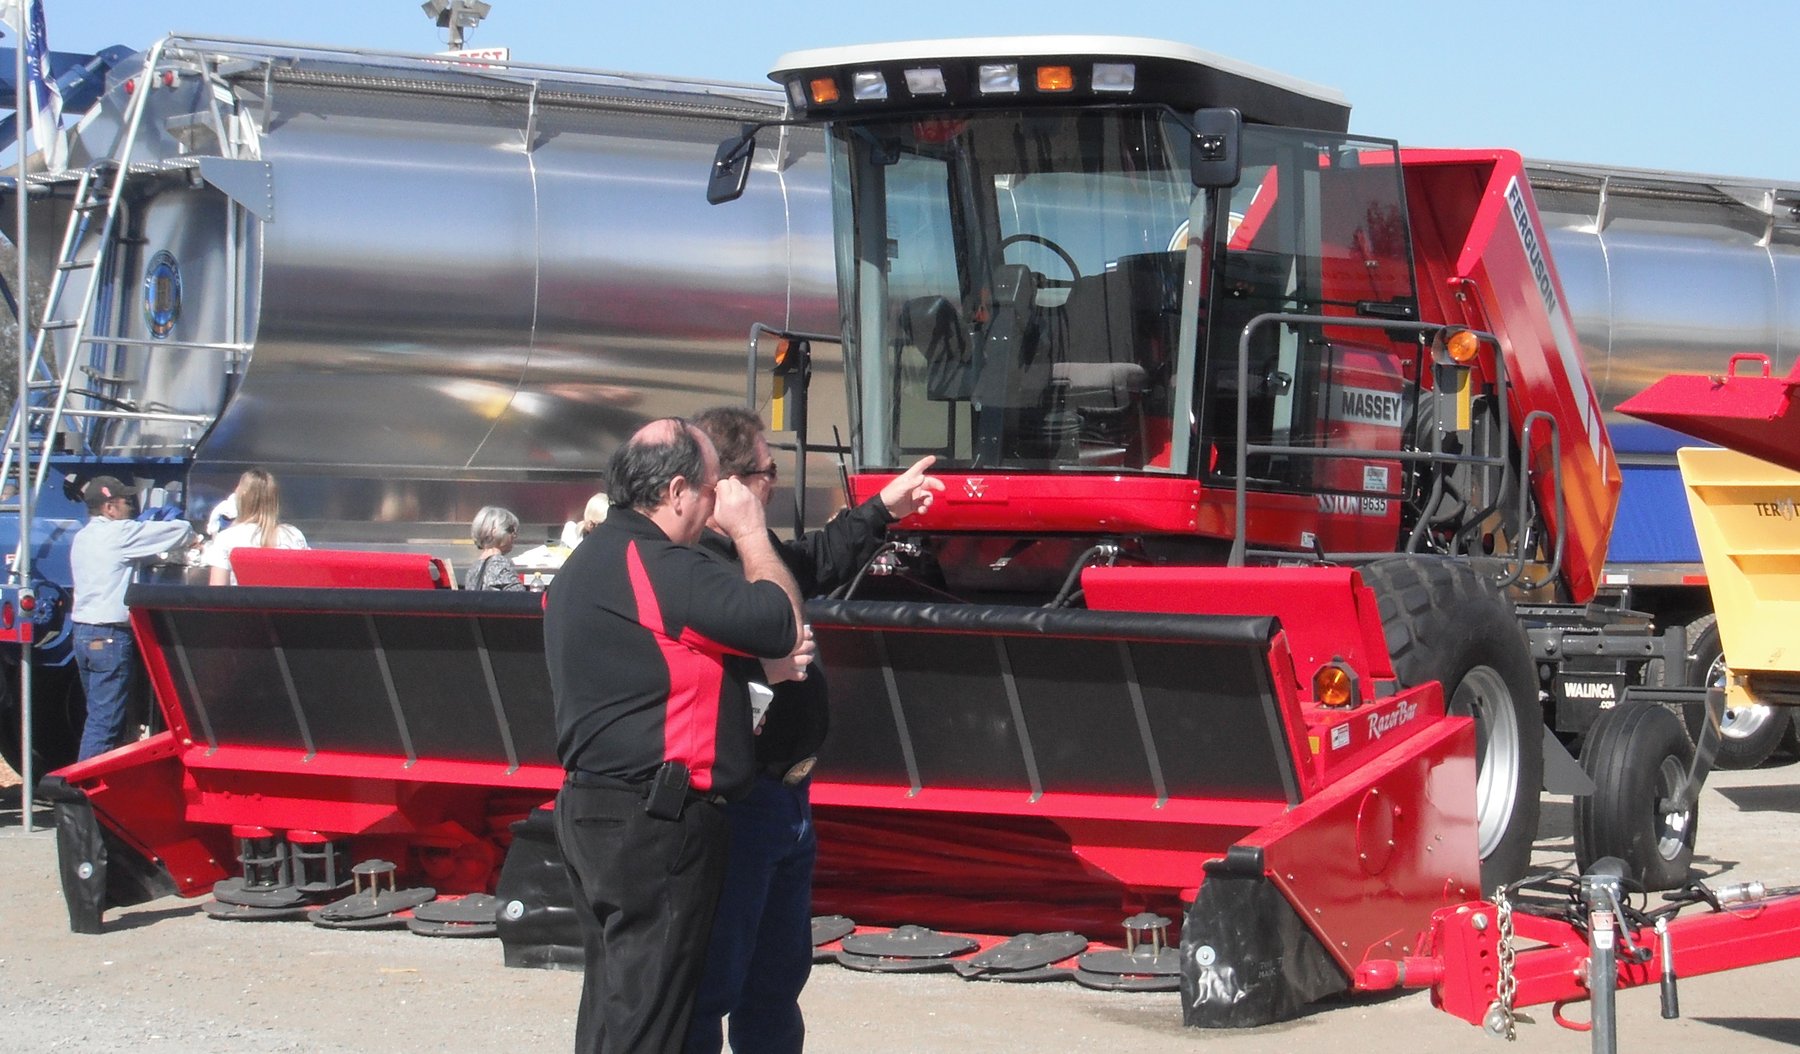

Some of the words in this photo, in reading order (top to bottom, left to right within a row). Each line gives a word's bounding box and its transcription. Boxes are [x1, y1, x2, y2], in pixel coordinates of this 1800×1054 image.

[1508, 184, 1556, 314] FERGUSON
[1342, 392, 1400, 421] MASSEY
[1362, 498, 1386, 512] 9635
[1564, 682, 1615, 698] WALINGA
[1367, 701, 1417, 740] RazorBar
